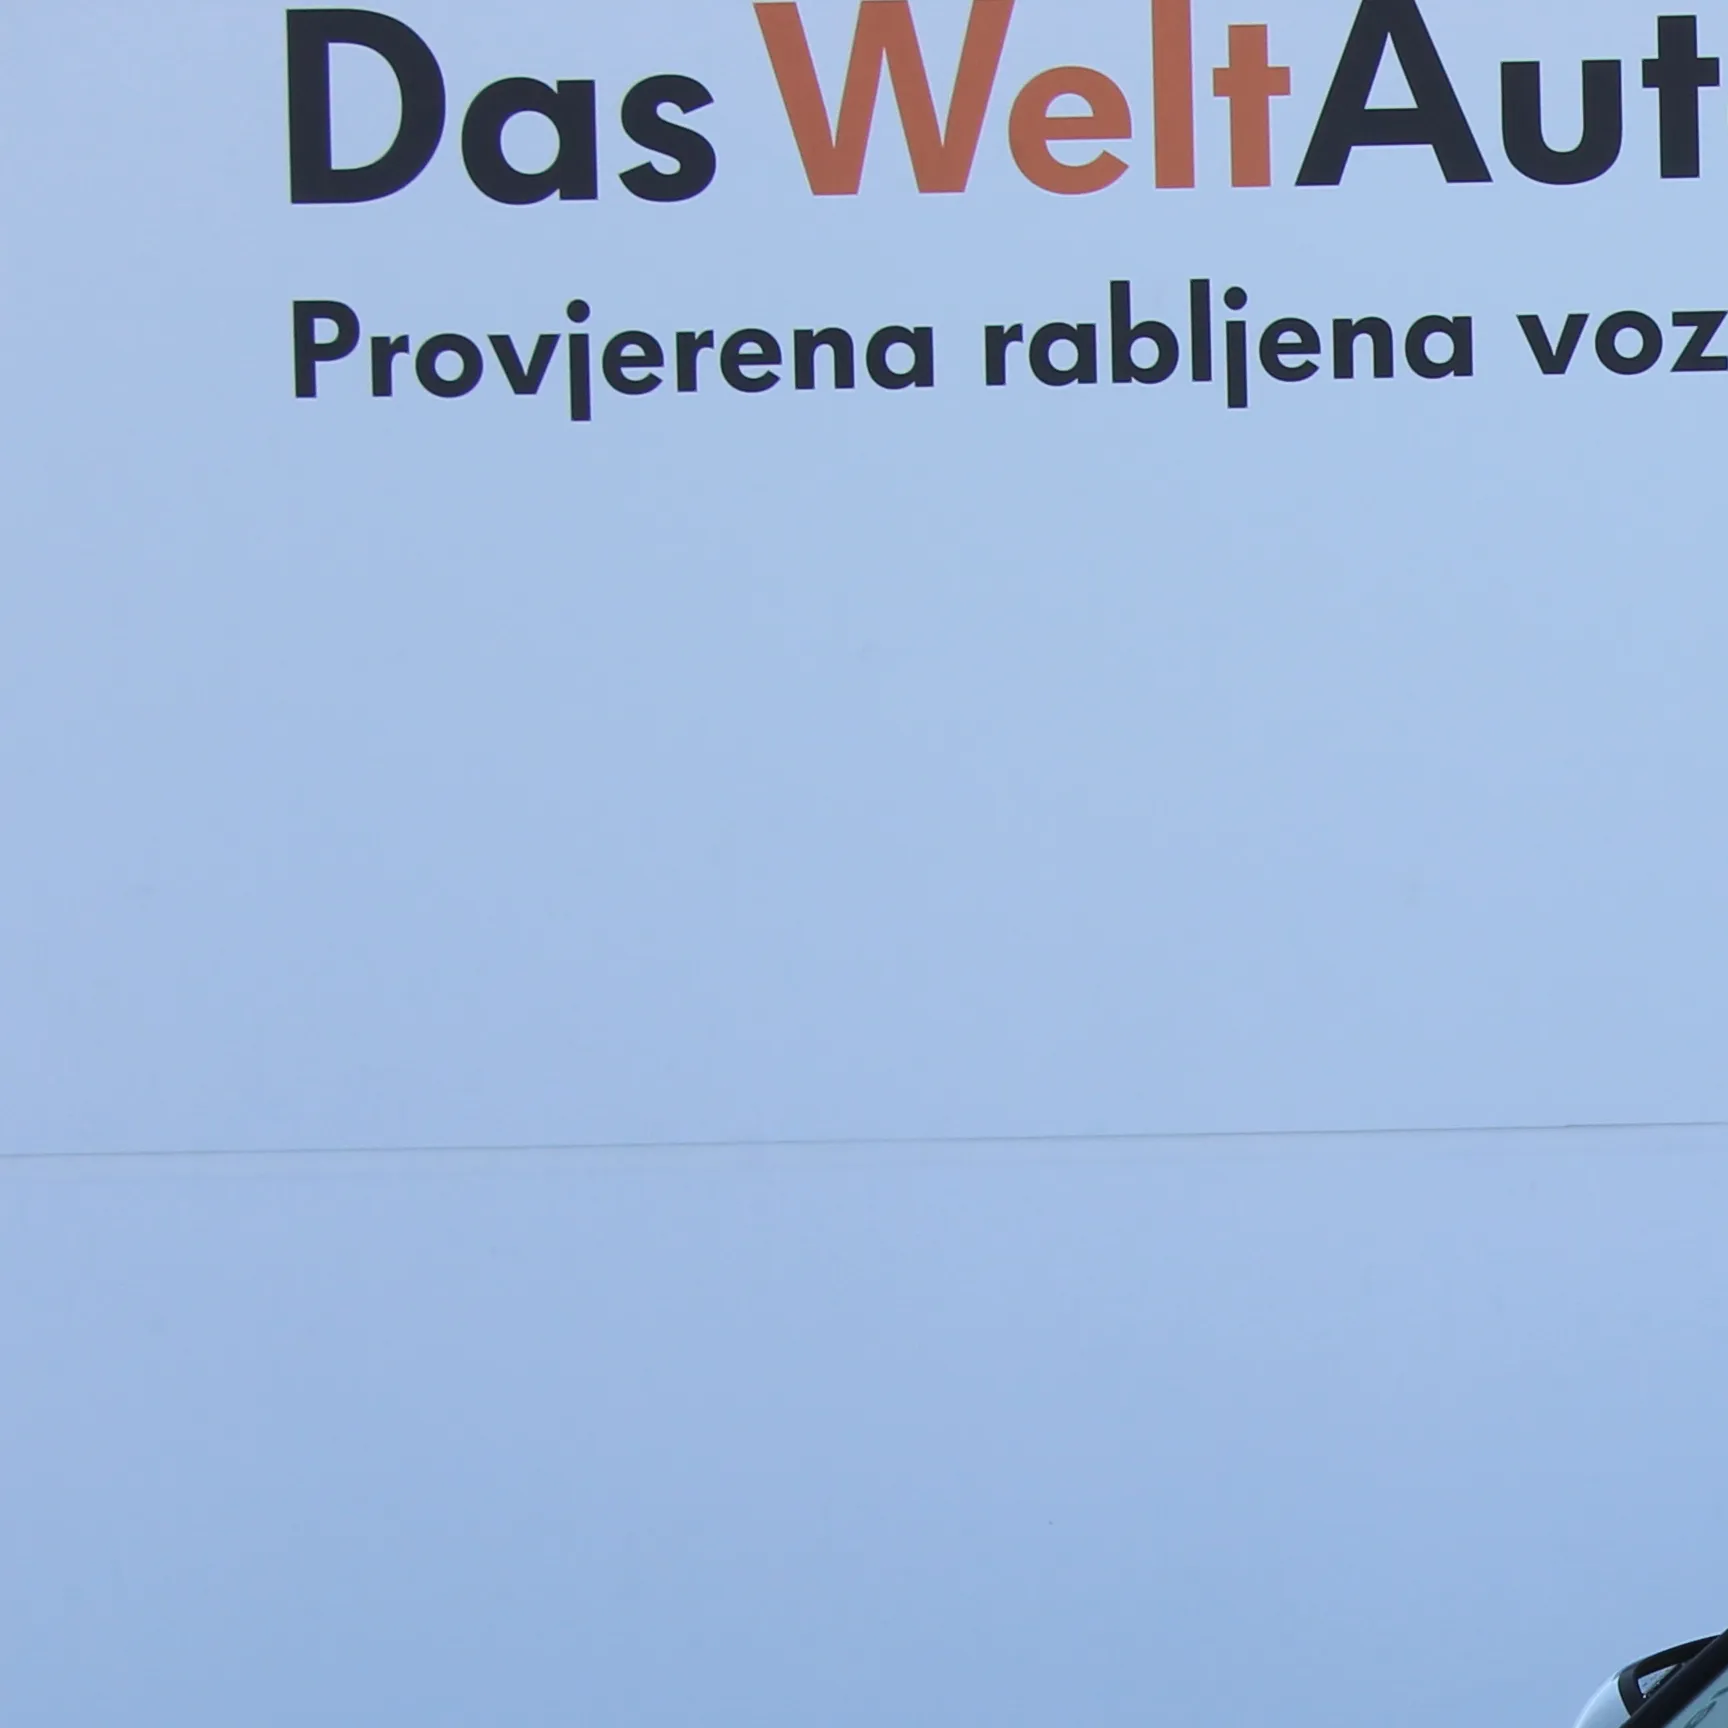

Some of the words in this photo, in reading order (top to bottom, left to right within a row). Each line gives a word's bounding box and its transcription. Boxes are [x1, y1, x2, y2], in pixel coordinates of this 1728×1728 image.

[286, 8, 717, 206] Das
[292, 298, 935, 422] Provjerena
[984, 278, 1474, 409] rabljena
